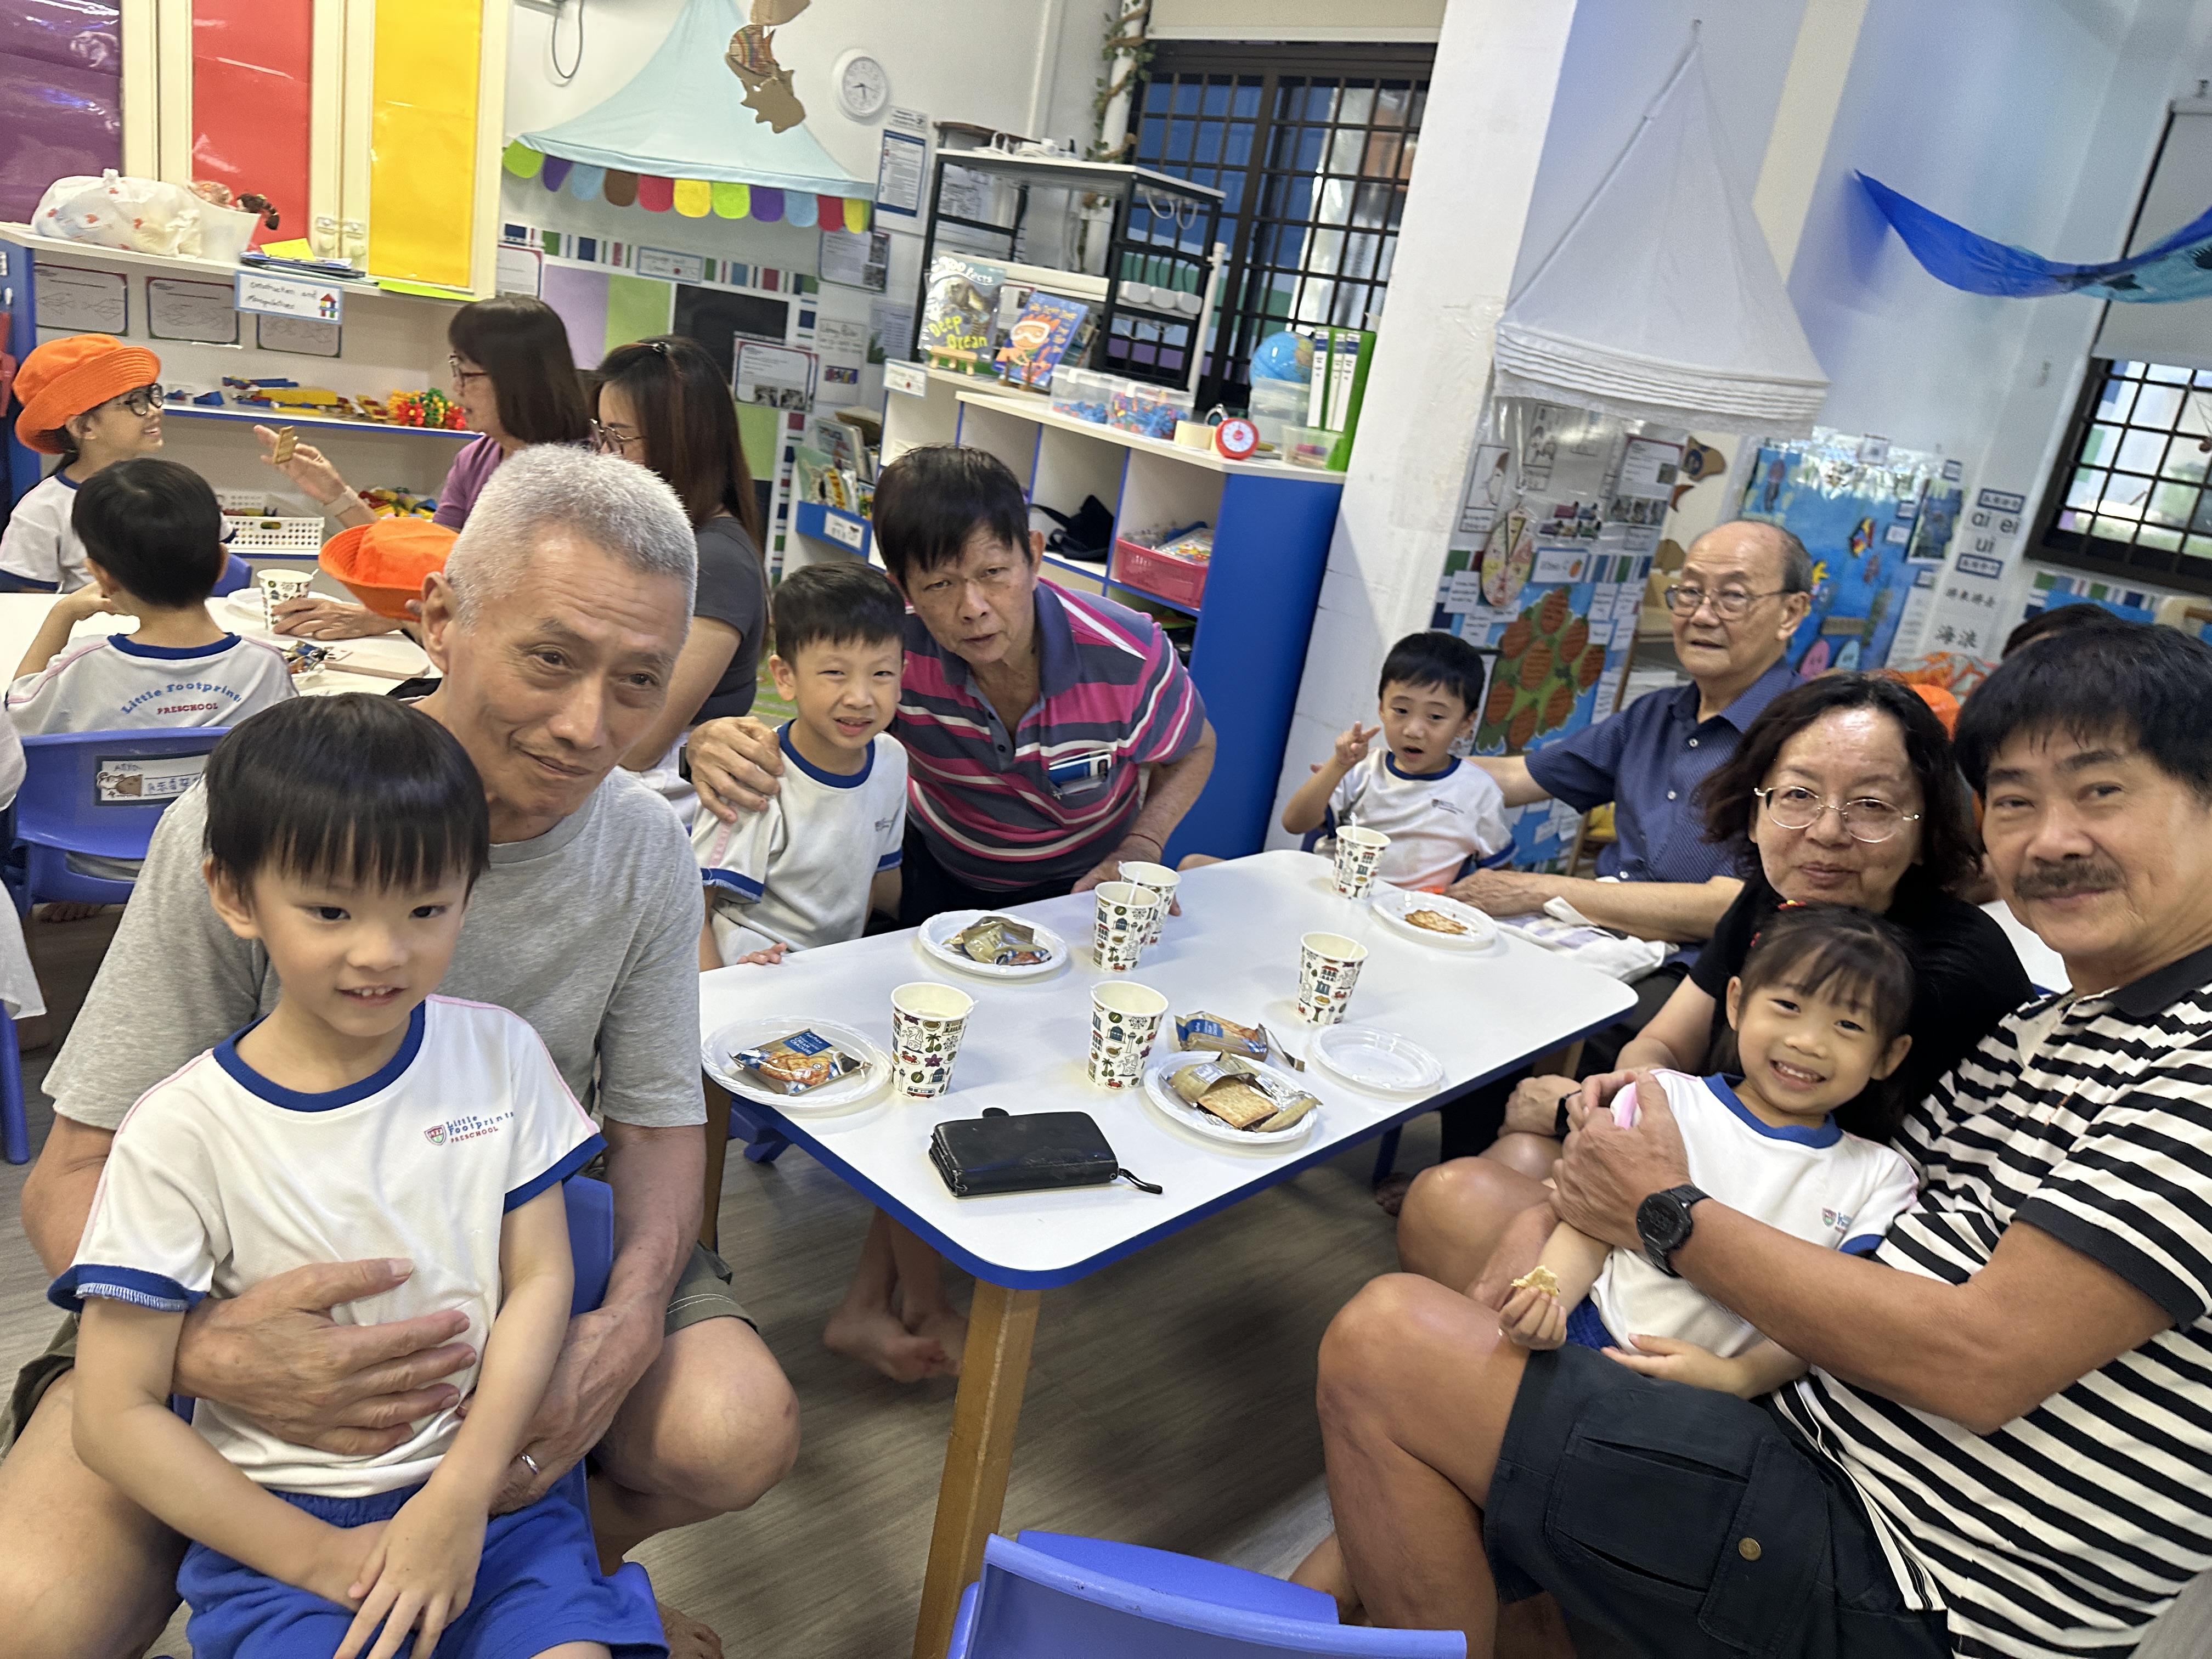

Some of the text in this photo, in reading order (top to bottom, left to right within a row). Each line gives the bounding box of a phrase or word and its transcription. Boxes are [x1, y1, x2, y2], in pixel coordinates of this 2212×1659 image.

[120, 689, 162, 714] Little
[157, 703, 218, 714] PRESCHOOL
[794, 1037, 810, 1048] CREAM
[445, 1115, 478, 1129] Little
[449, 1111, 514, 1136] Footprints
[450, 1126, 499, 1143] PRESCHOOL
